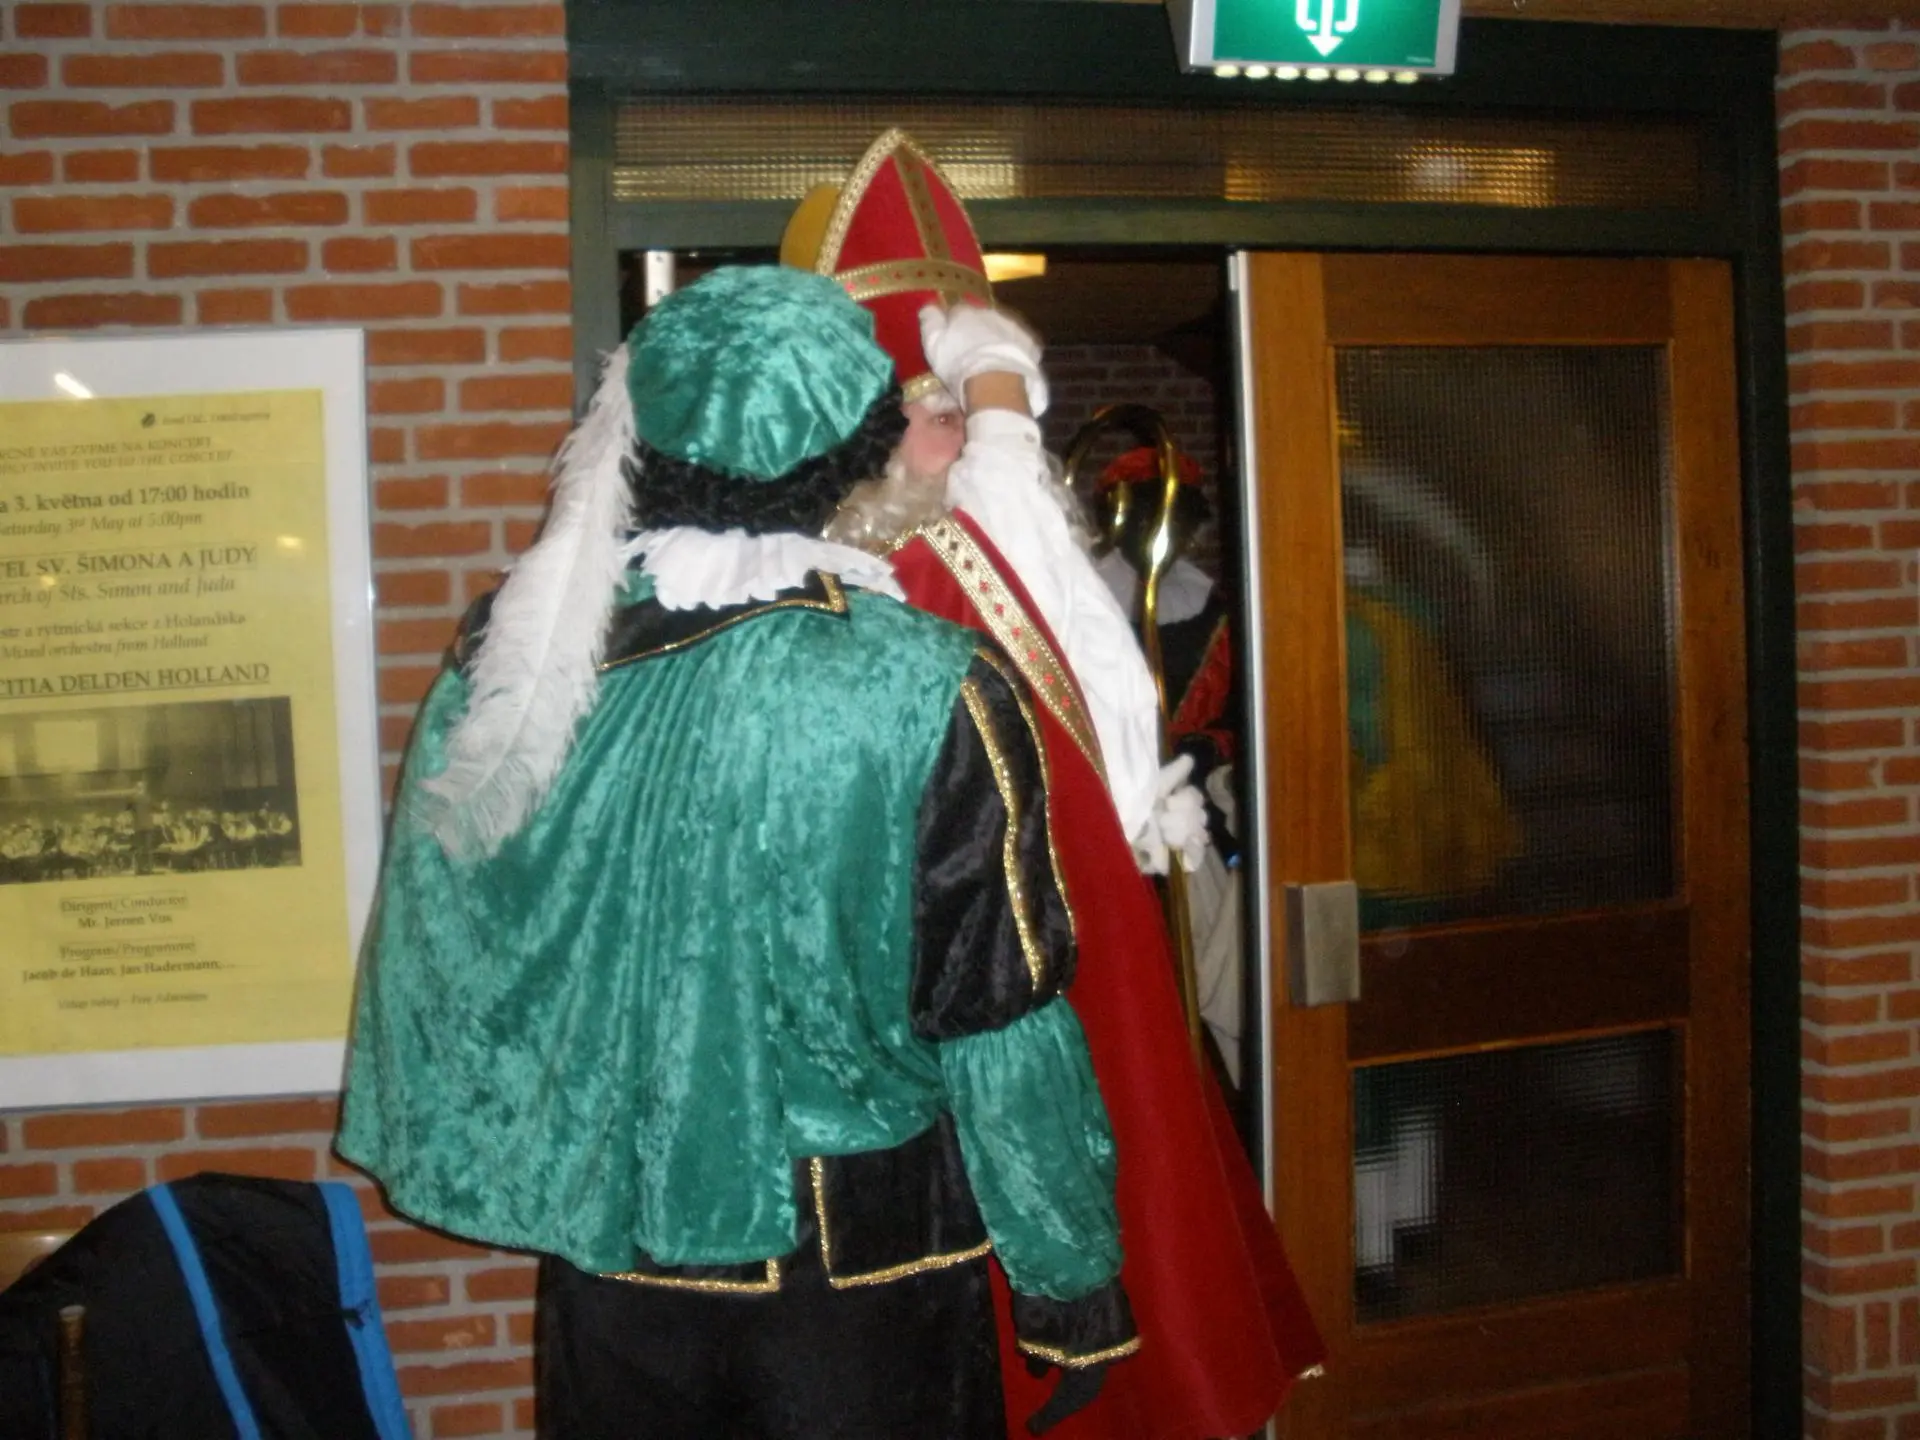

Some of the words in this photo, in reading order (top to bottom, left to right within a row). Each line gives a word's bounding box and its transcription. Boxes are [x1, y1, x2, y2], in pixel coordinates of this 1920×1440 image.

[14, 494, 31, 513] 3.
[35, 492, 103, 511] května
[108, 487, 133, 506] od
[139, 484, 187, 505] 17:00
[192, 481, 250, 501] hodin
[91, 515, 124, 534] May
[128, 516, 142, 528] at
[147, 511, 202, 531] 5:00pm
[36, 557, 71, 576] SV.
[76, 552, 172, 574] ŠIMONA
[179, 550, 193, 569] A
[199, 546, 256, 571] JUDY
[37, 587, 53, 608] of
[97, 580, 152, 600] Simon
[157, 577, 190, 596] and
[114, 637, 148, 658] from
[58, 670, 150, 693] DELDEN
[157, 663, 270, 686] HOLLAND
[61, 966, 77, 979] de
[120, 963, 142, 978] Jan
